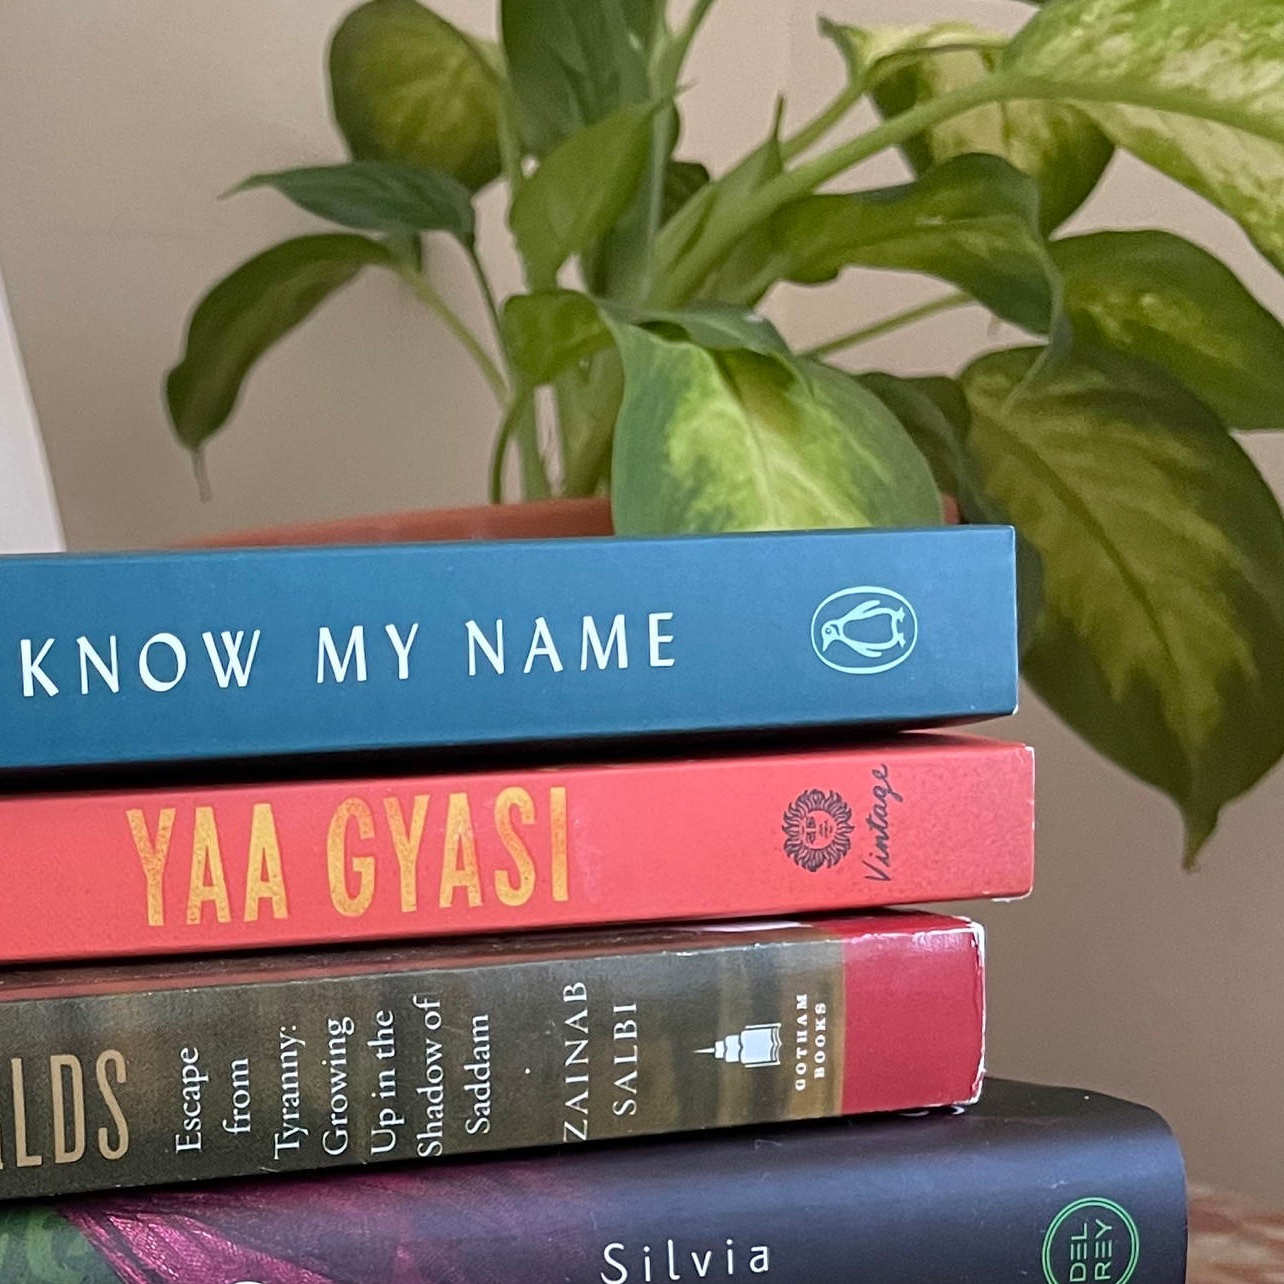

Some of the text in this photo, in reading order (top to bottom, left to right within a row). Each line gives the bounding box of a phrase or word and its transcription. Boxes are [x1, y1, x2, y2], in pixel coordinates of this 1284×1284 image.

[20, 612, 675, 697] KNOW MY NAME
[126, 786, 569, 927] YAA GYASI
[862, 763, 903, 881] Vintage
[222, 1057, 251, 1135] from
[273, 1025, 309, 1160] Tyranny:
[322, 1016, 355, 1156] Growing
[367, 1010, 405, 1155] Up in the
[413, 994, 444, 1158] Shadow of
[464, 1014, 491, 1134] Saddam
[562, 981, 589, 1142] ZAINAB
[612, 1002, 638, 1116] SALBI
[795, 993, 808, 1091] GOTHAM
[814, 1002, 826, 1079] BOOKS
[175, 1047, 209, 1154] Escape
[1070, 1222, 1087, 1282] DEL
[1095, 1218, 1112, 1280] REY
